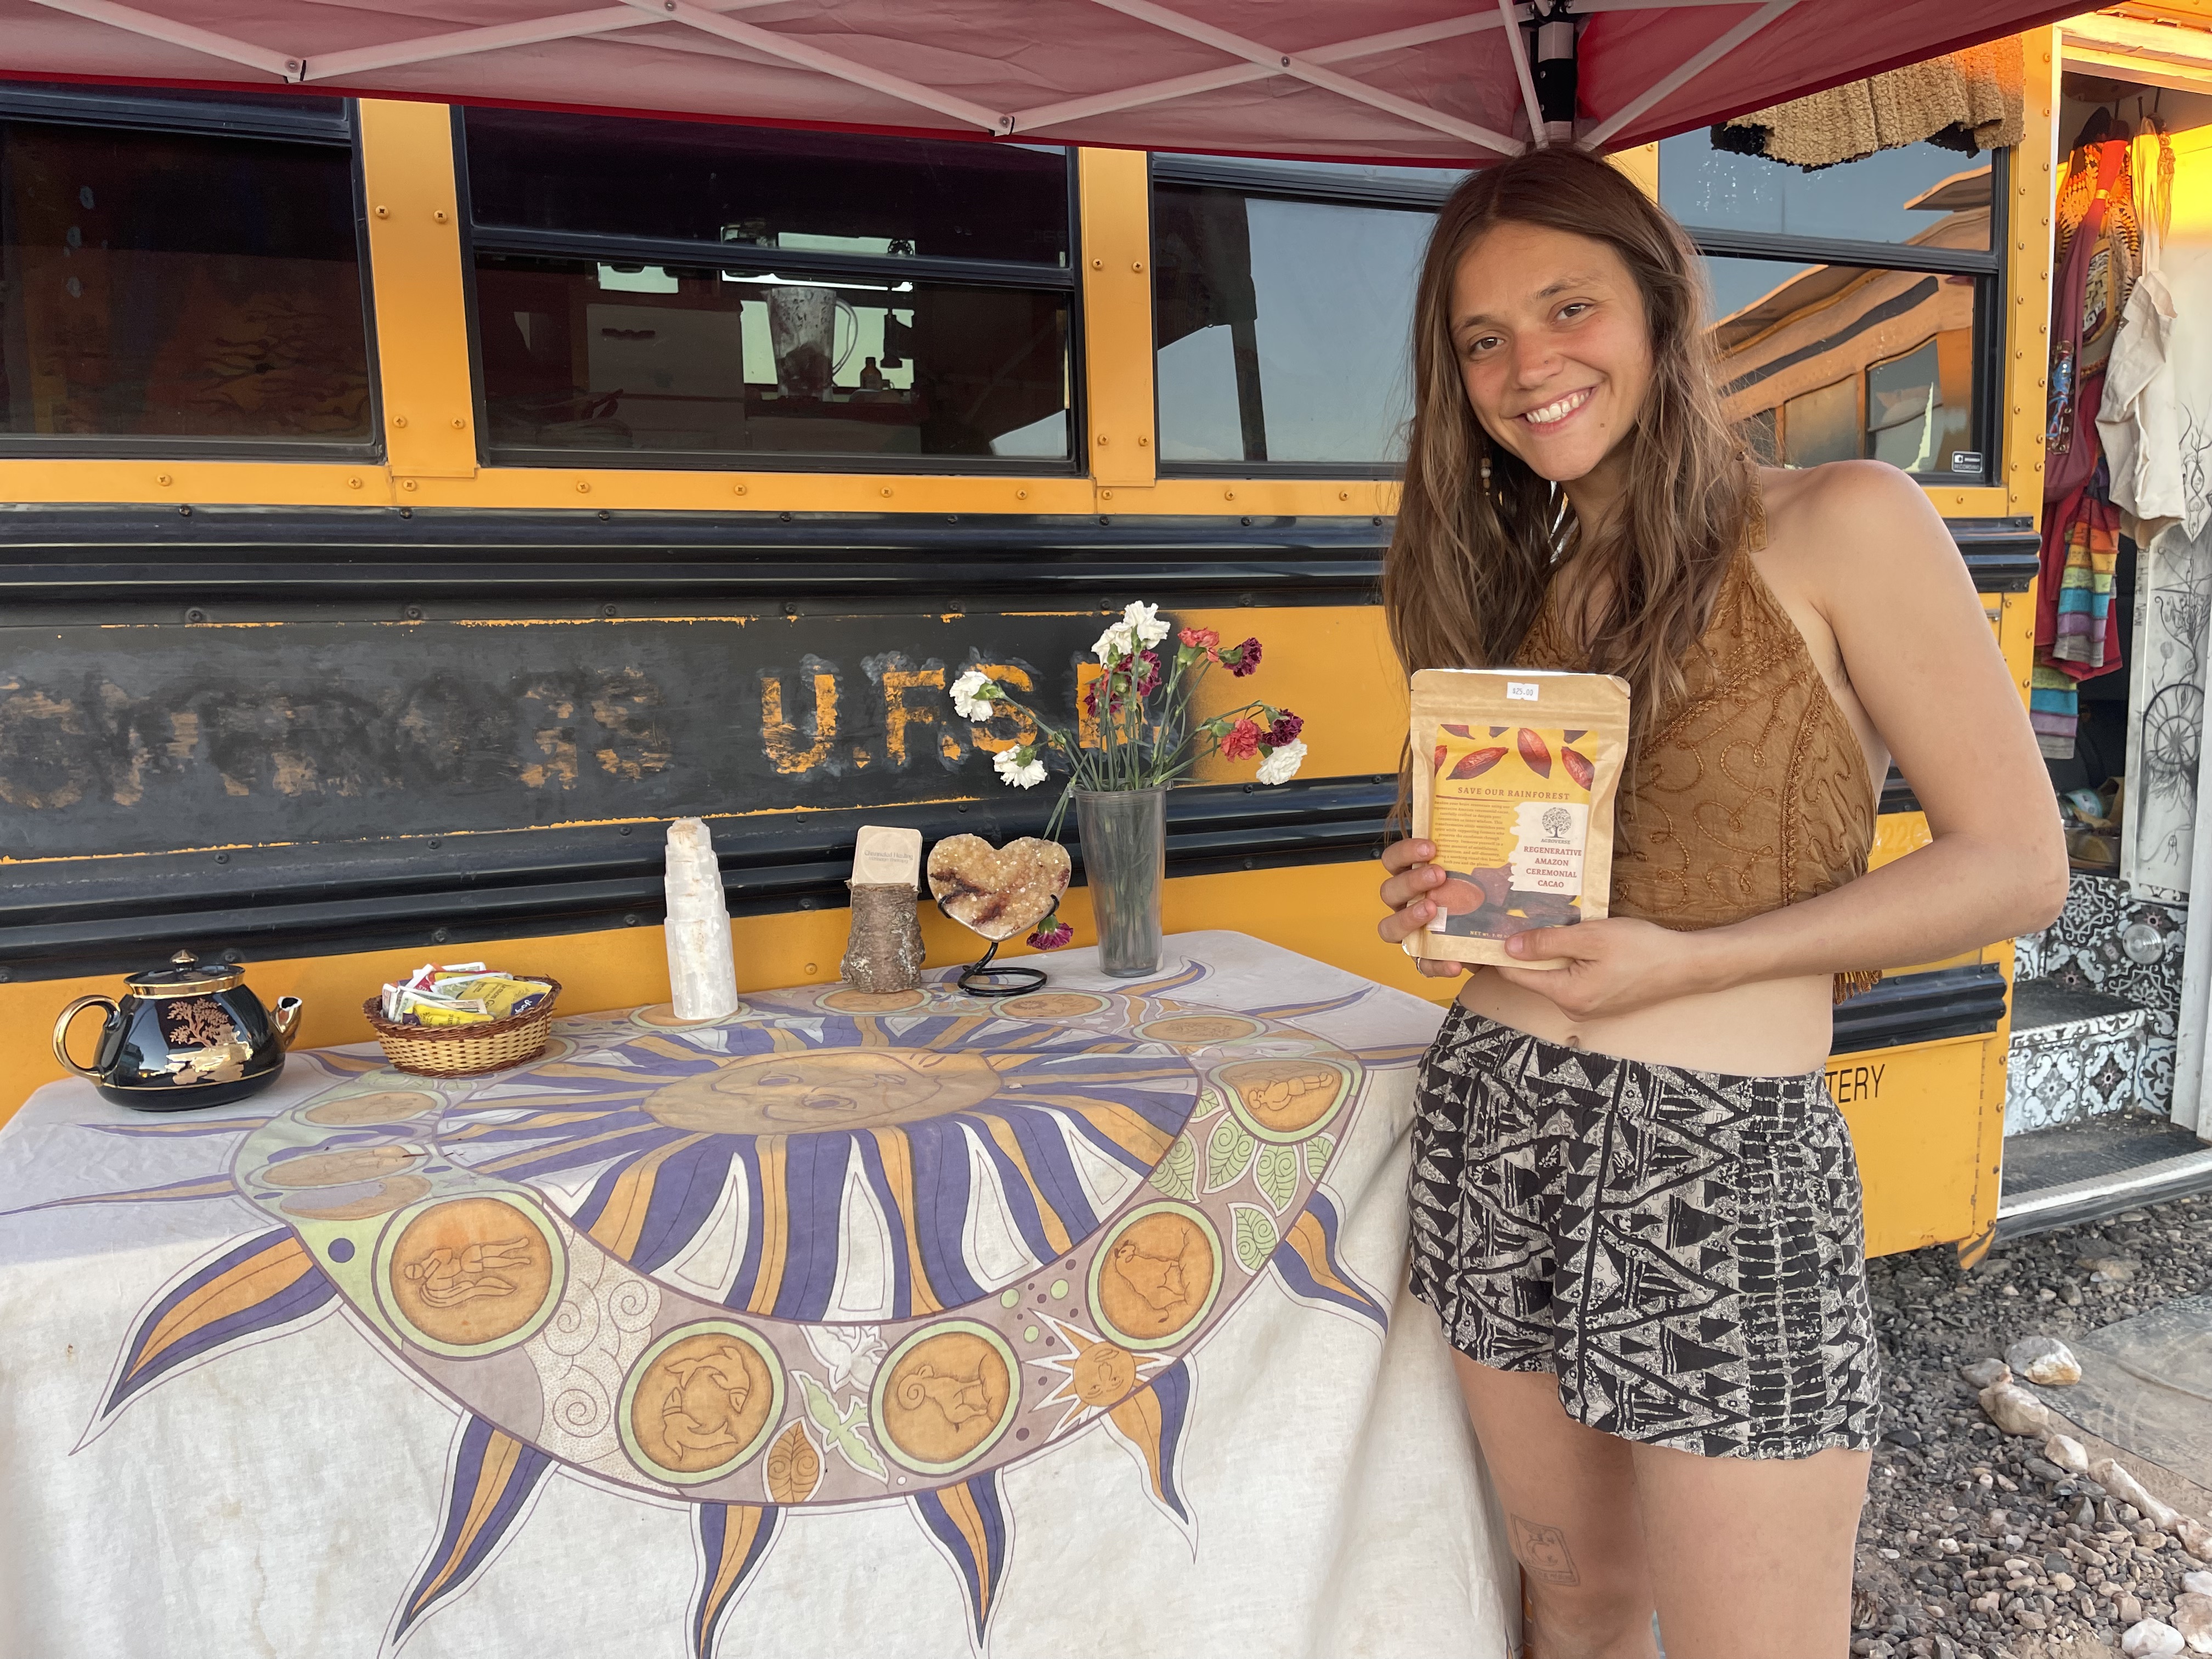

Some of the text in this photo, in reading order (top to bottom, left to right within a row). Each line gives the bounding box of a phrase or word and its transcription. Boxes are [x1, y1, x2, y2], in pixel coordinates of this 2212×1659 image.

[1513, 687, 1533, 696] $25.00
[1508, 790, 1570, 800] RAINFOREST
[1523, 846, 1582, 856] REGENERATIVE
[1534, 857, 1569, 866] AMAZON
[1526, 868, 1577, 878] CEREMONIAL
[514, 998, 533, 1014] yog
[1825, 1064, 1886, 1104] TERY
